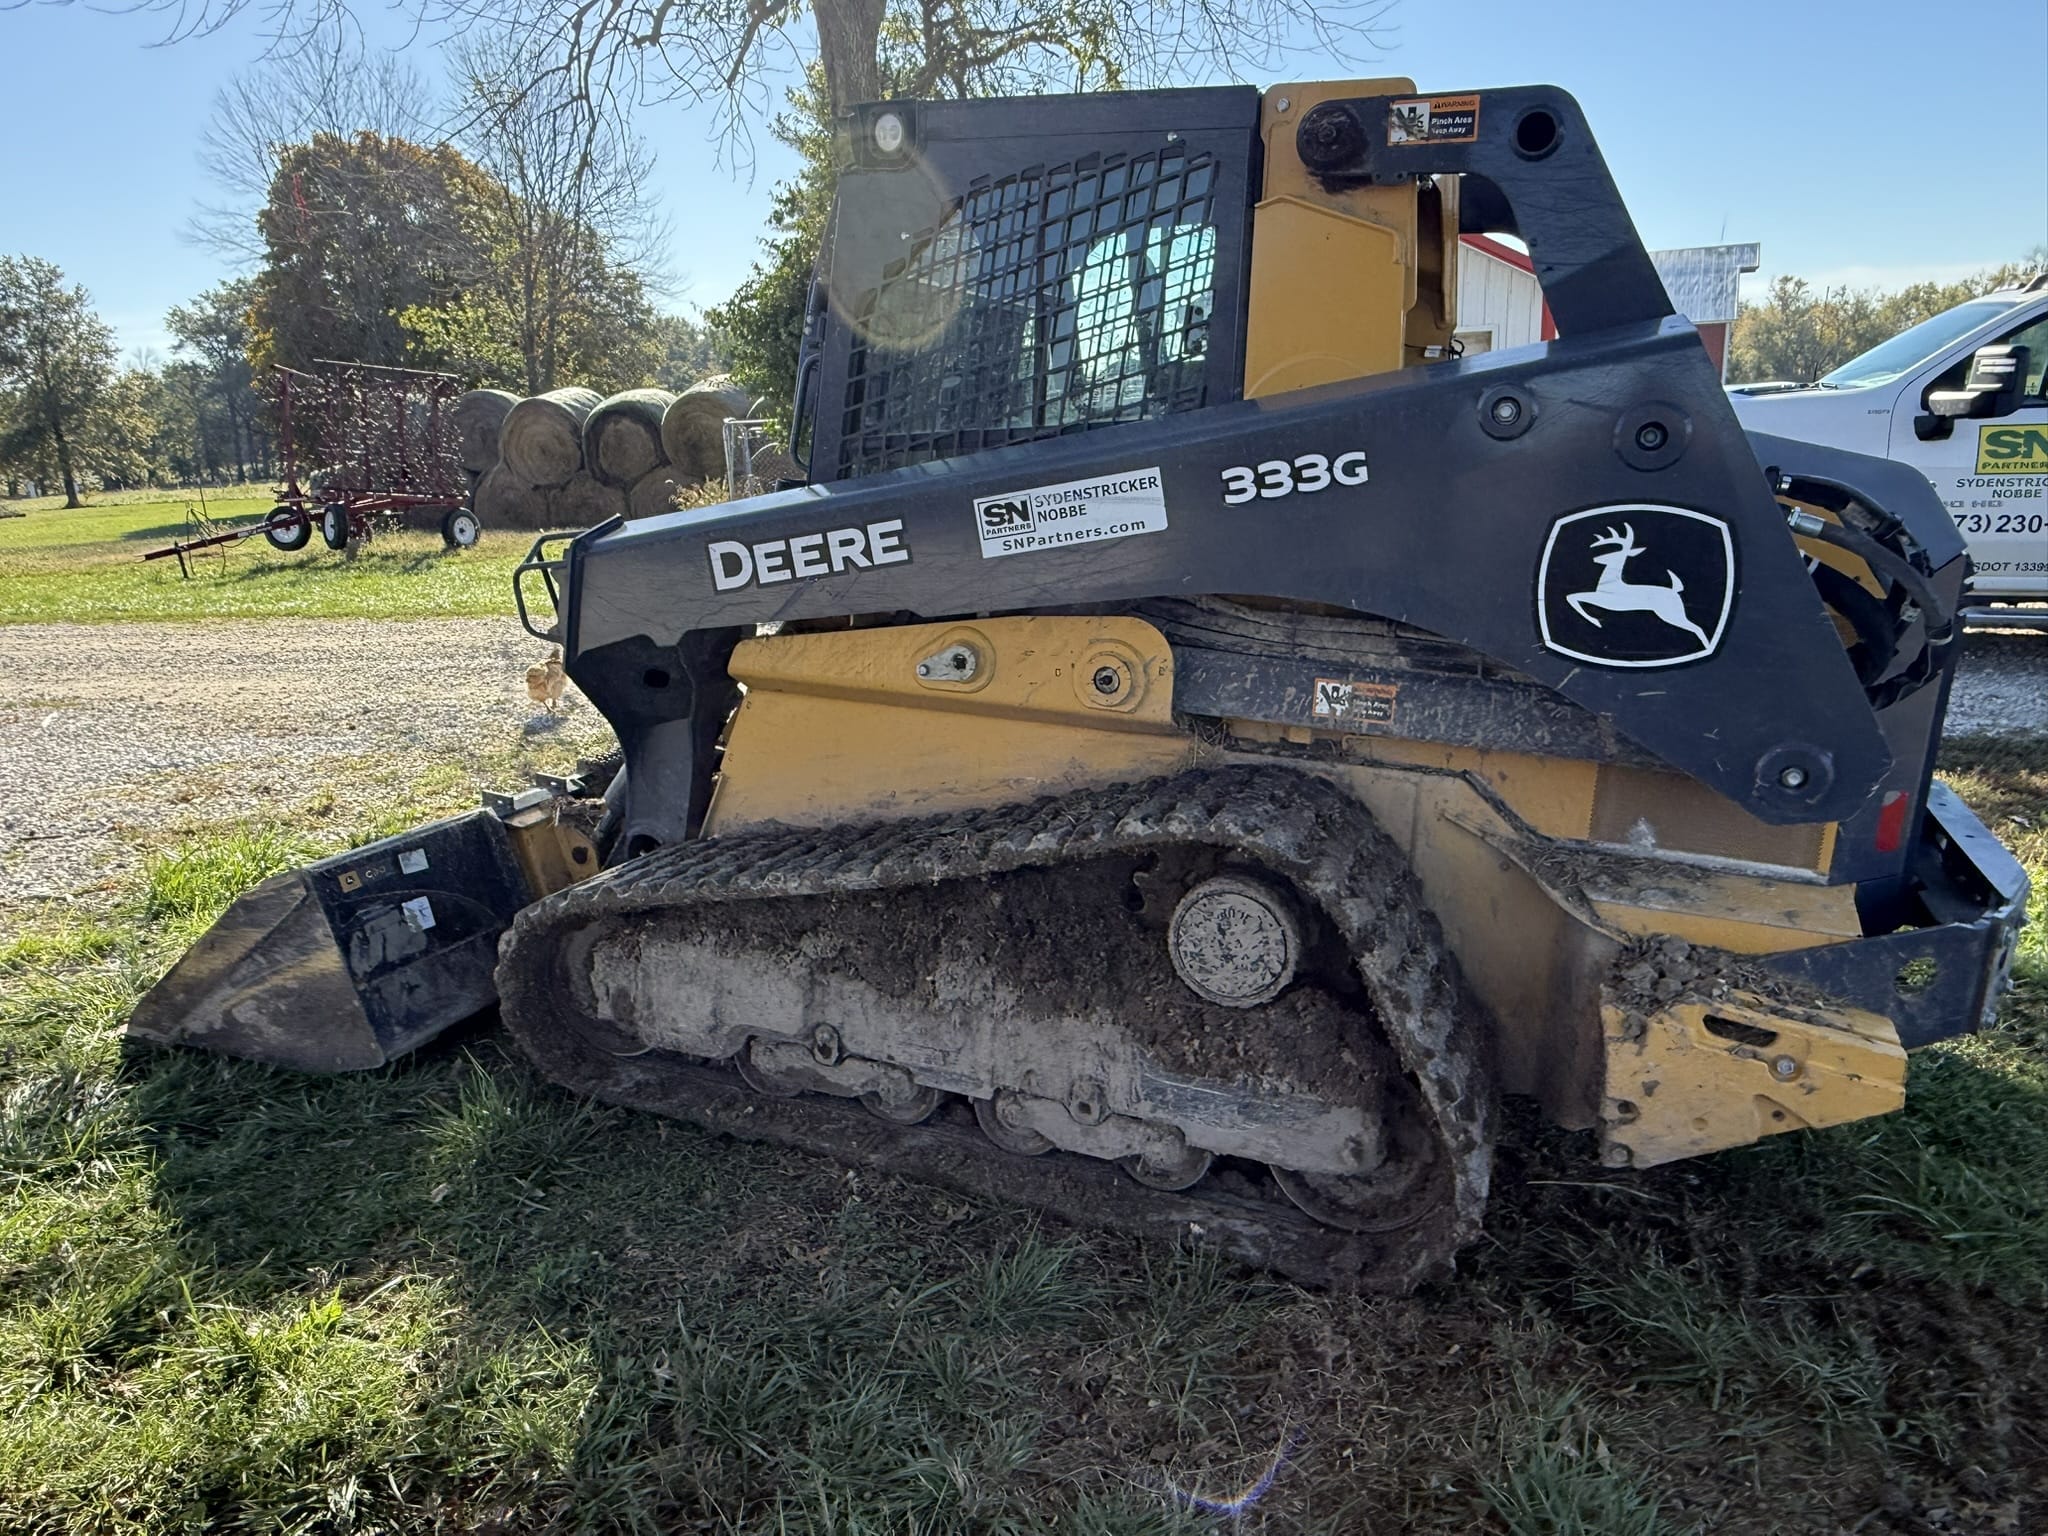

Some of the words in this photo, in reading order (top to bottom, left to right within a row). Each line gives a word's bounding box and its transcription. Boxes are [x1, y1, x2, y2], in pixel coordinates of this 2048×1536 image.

[1431, 117, 1453, 125] Pinch
[1454, 116, 1473, 124] Area
[1448, 126, 1466, 134] Away
[1984, 429, 2048, 459] SN
[1221, 451, 1369, 504] 333G
[1034, 476, 1159, 508] SYDENSTRICKER
[1992, 488, 2042, 498] NOBBE
[983, 499, 1030, 527] SN
[1037, 503, 1088, 523] NOBBE
[985, 522, 1032, 536] PARTNERS
[1002, 520, 1146, 551] SNPartners.com
[708, 519, 909, 591] DEERE
